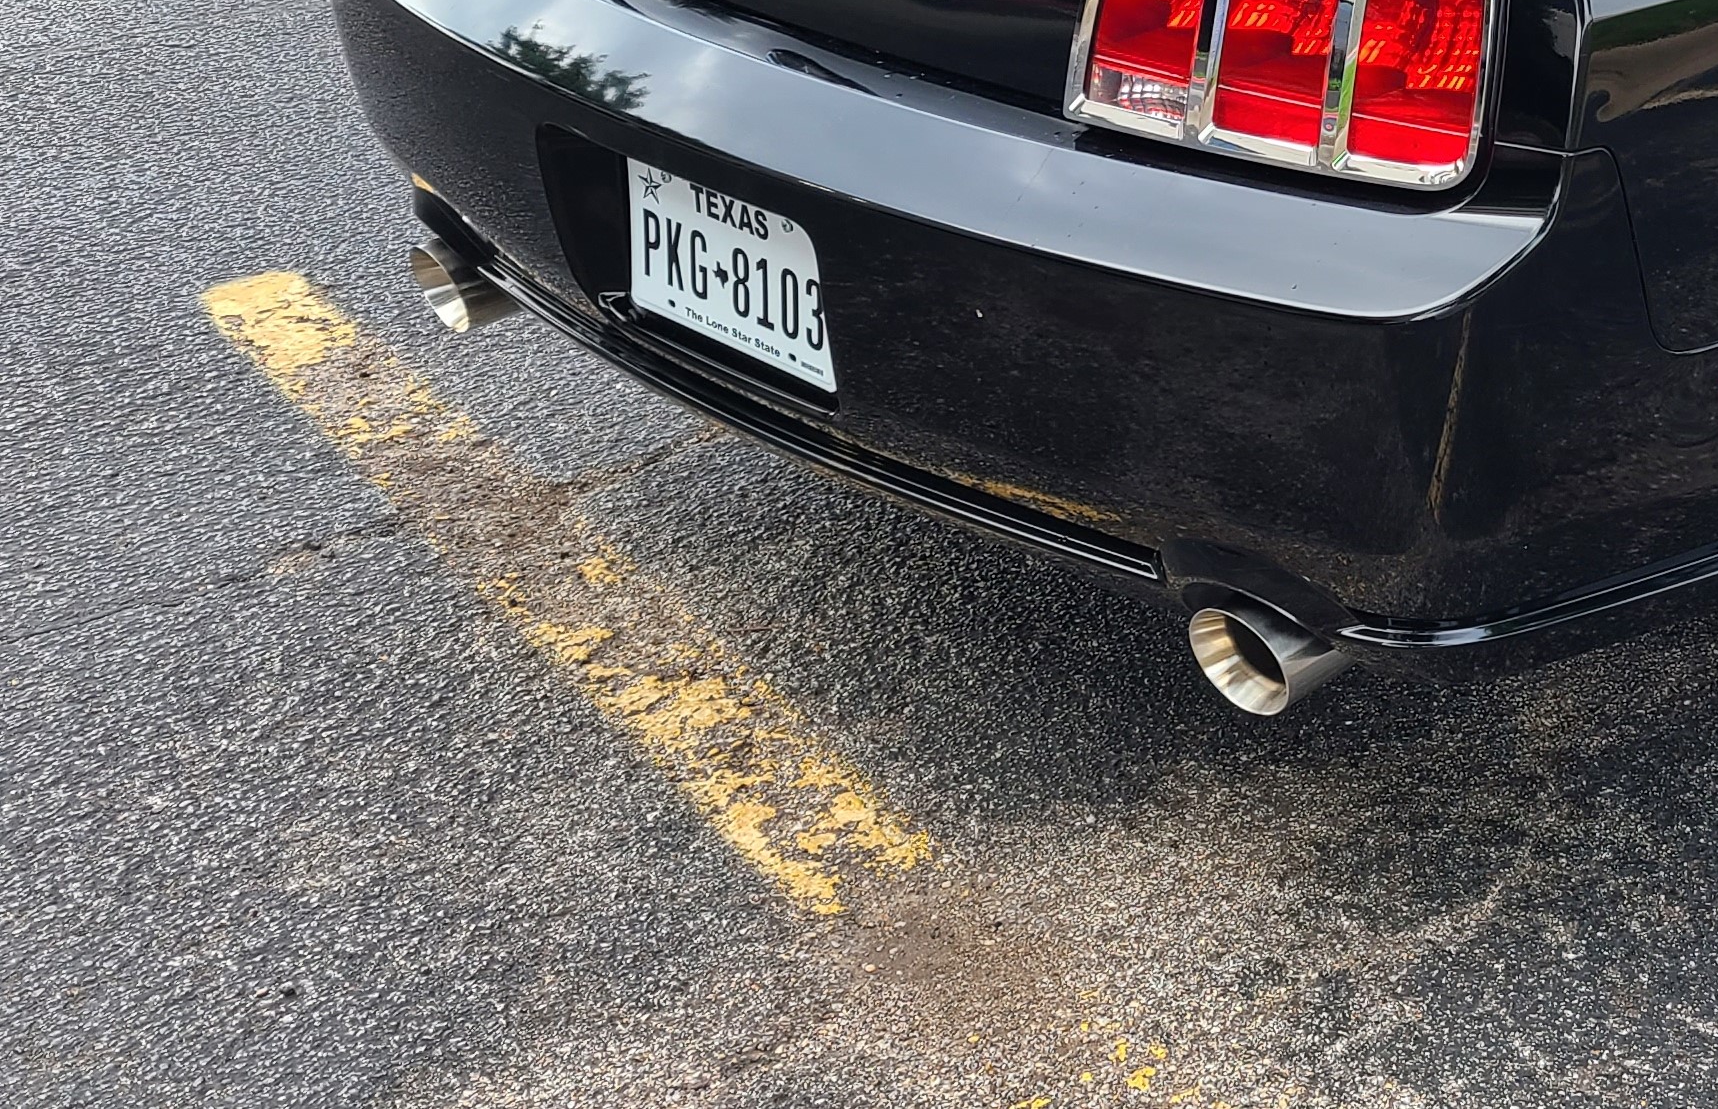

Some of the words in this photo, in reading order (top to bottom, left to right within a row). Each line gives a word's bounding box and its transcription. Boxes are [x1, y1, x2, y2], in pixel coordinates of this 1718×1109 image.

[689, 183, 769, 240] TEXAS
[642, 208, 708, 300] PKG
[731, 247, 824, 351] 8103
[684, 306, 703, 323] The
[705, 315, 729, 334] Lone
[731, 327, 752, 343] Star
[754, 337, 780, 358] State
